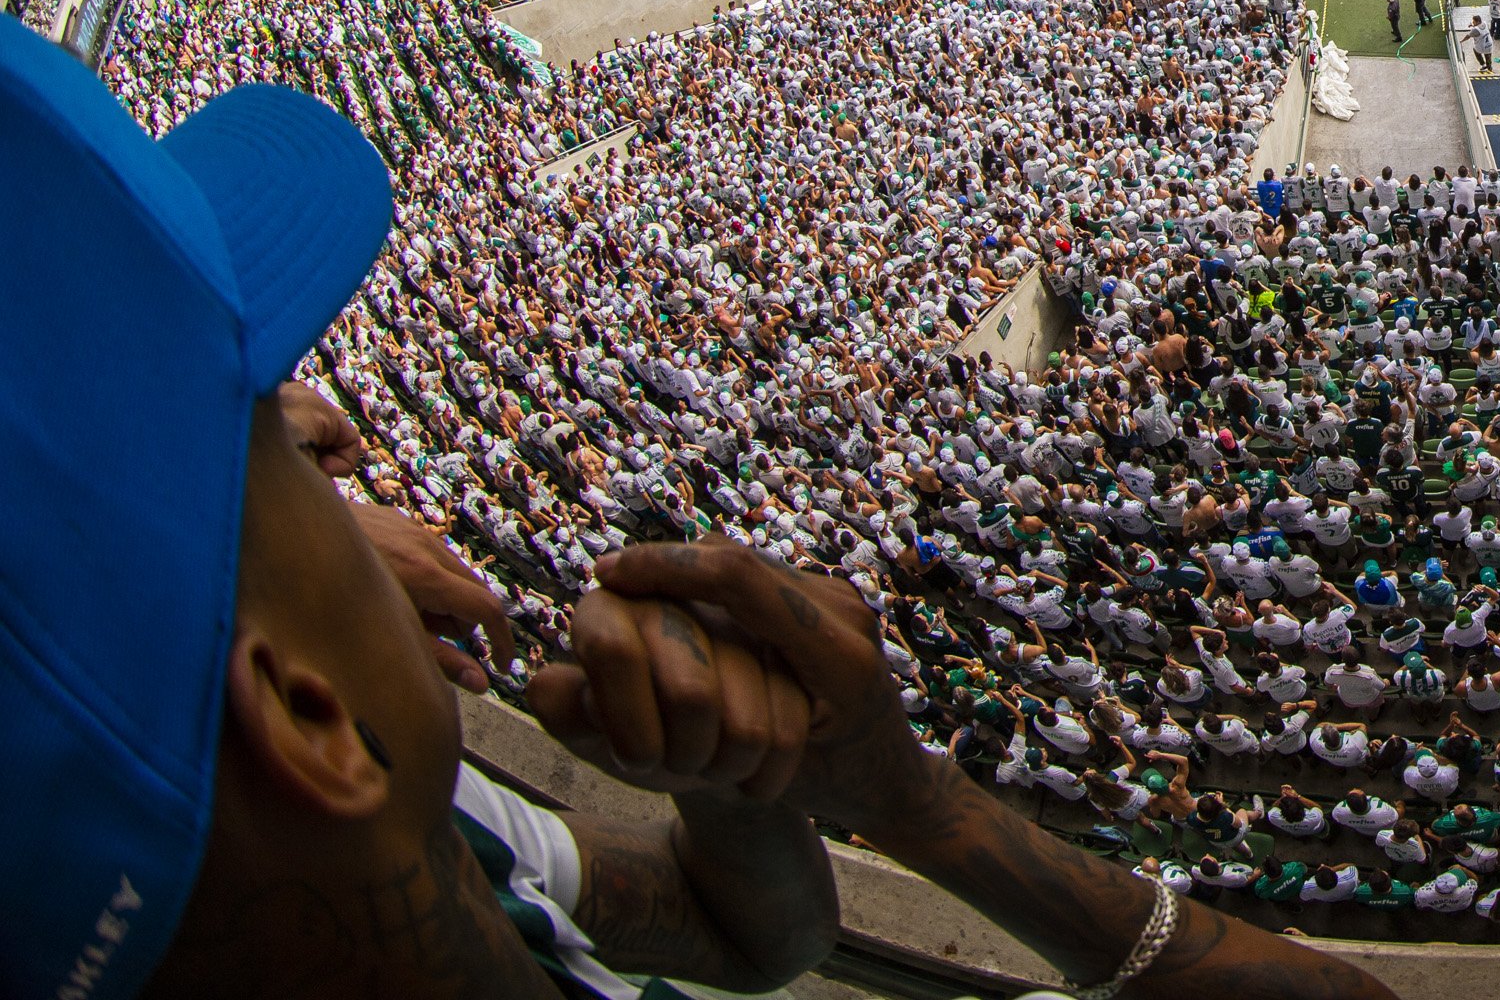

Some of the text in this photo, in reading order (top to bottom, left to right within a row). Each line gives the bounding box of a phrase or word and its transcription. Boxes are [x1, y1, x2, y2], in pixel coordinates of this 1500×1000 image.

[1324, 297, 1335, 308] 5
[1433, 309, 1445, 319] 9
[1317, 428, 1331, 439] 11
[1244, 477, 1261, 486] crefis
[1390, 479, 1410, 491] 10
[1315, 521, 1338, 529] crefisa
[1248, 534, 1273, 545] crefisa
[1277, 566, 1300, 574] crefisa
[1269, 679, 1292, 690] crefisa
[1275, 732, 1296, 746] crefisa
[1273, 876, 1297, 894] crefisa
